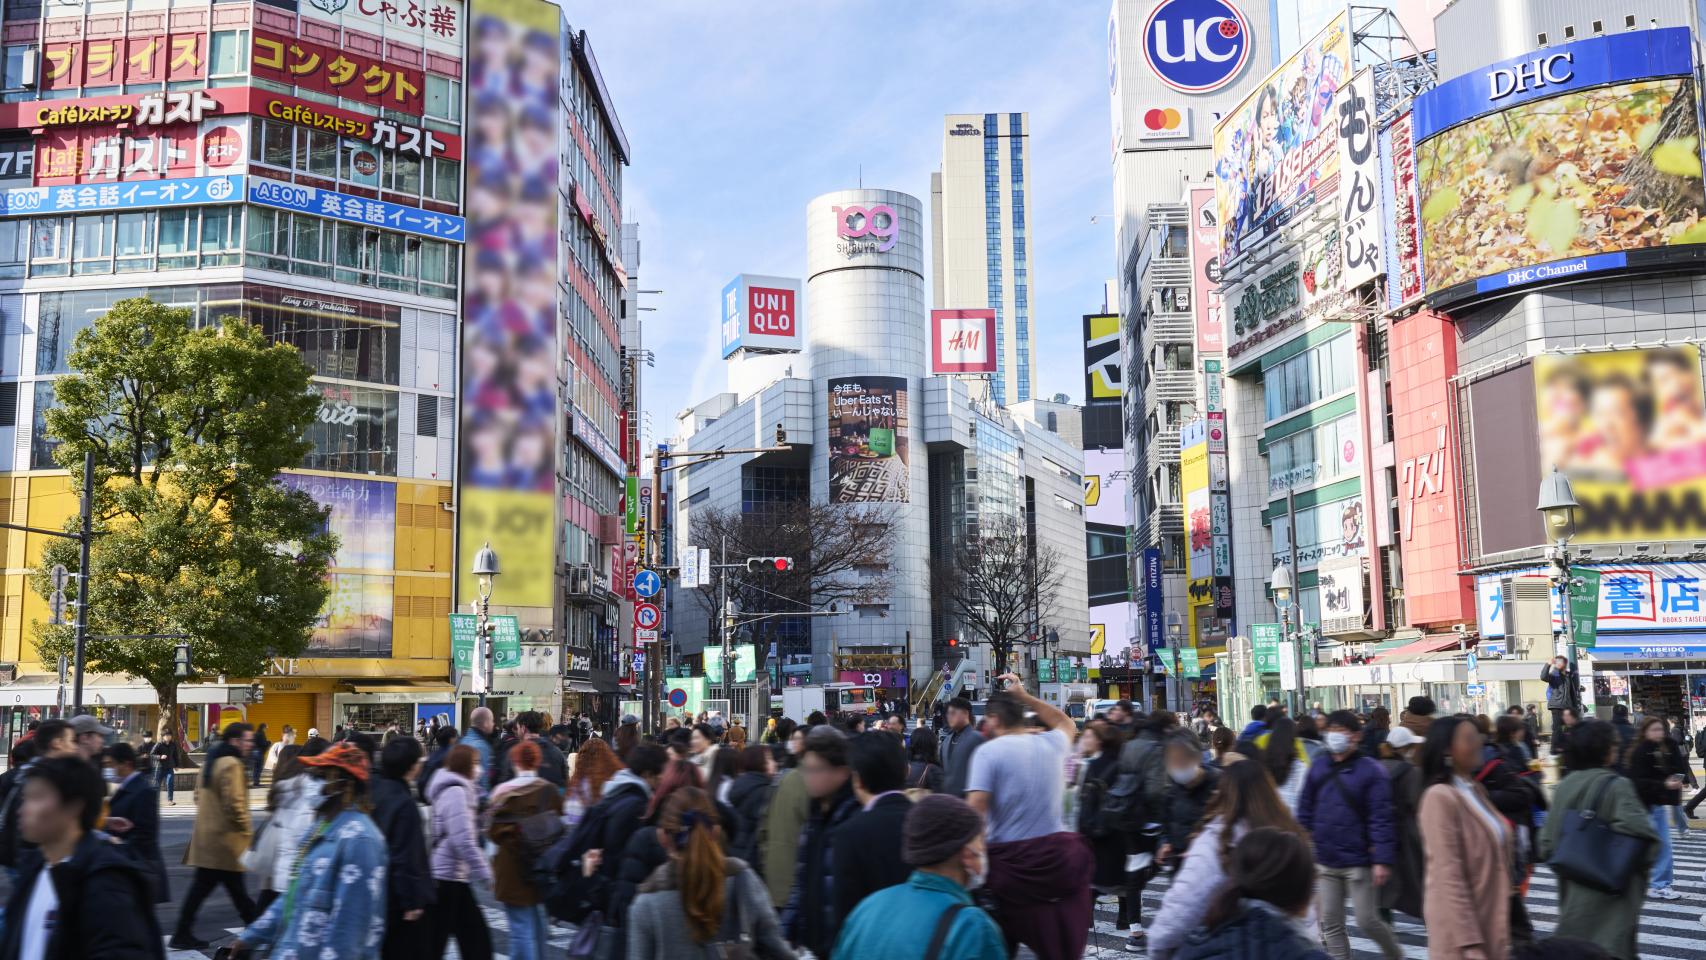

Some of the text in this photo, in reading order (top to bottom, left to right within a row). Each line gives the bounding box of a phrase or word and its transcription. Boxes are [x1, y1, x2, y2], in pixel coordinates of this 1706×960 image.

[357, 0, 457, 38] しゃぶ葉
[1155, 16, 1239, 64] UC
[46, 38, 202, 79] プライス
[254, 36, 418, 101] コンタクト
[1487, 53, 1573, 101] DHC
[136, 91, 216, 125] ガスト
[206, 145, 238, 157] ガスト
[372, 119, 445, 158] ガスト
[0, 152, 33, 175] 7F
[89, 137, 187, 181] ガスト
[1339, 86, 1379, 273] もんじゃ
[256, 182, 309, 207] AEON
[831, 204, 899, 252] 109
[1507, 261, 1588, 285] DHC Channel
[753, 292, 787, 312] UNI
[753, 312, 790, 333] QLO
[948, 329, 981, 352] H&M
[832, 383, 867, 395] 今年も、
[833, 396, 858, 407] Uber
[858, 395, 881, 405] Eats
[1402, 424, 1447, 542] クスリ
[627, 495, 635, 514] レイク
[626, 566, 636, 589] アコム
[1150, 557, 1158, 588] MIZUHO
[1150, 611, 1159, 646] みずほ銀行
[1662, 616, 1682, 624] BOOKS
[862, 673, 882, 687] 109
